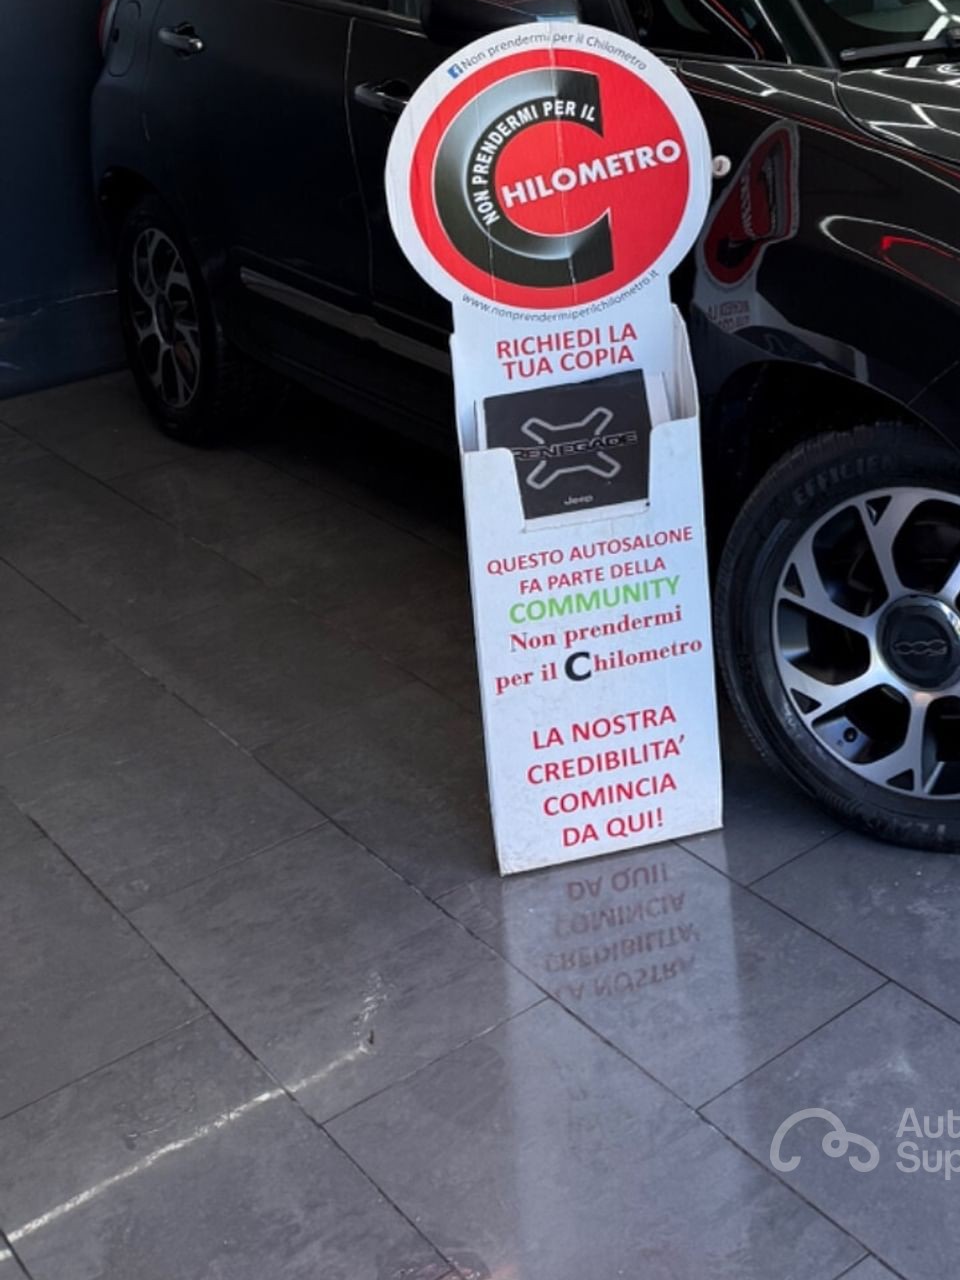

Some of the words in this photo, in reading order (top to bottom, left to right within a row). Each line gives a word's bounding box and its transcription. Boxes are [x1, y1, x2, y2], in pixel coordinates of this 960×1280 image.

[461, 52, 486, 70] Non
[552, 33, 574, 43] per
[576, 33, 585, 44] il
[586, 36, 647, 70] Chilometro
[542, 100, 577, 117] PER
[580, 103, 595, 122] IL
[472, 104, 538, 185] PRENDERMI
[501, 139, 682, 209] HILOMETRO
[472, 189, 500, 226] NON
[496, 327, 600, 359] RICHIEDI
[608, 322, 637, 343] LA
[502, 357, 553, 380] TUA
[560, 345, 634, 371] COPIA
[563, 494, 594, 506] Jeep
[487, 549, 564, 576] QUESTO
[569, 526, 693, 562] AUTOSALONE
[519, 578, 543, 595] FA
[547, 567, 604, 590] PARTE
[610, 556, 666, 579] DELLA
[509, 575, 680, 624] COMMUNITY
[510, 631, 557, 653] Non
[563, 604, 682, 649] prendermi
[495, 670, 534, 694] per
[541, 662, 558, 681] il
[564, 639, 703, 682] Chilometro
[532, 727, 564, 750] LA
[571, 705, 677, 743] NOSTRA
[526, 734, 686, 785] CREDIBILITA'
[542, 772, 677, 817] COMINCIA
[562, 823, 599, 847] DA
[606, 807, 664, 838] QUI!
